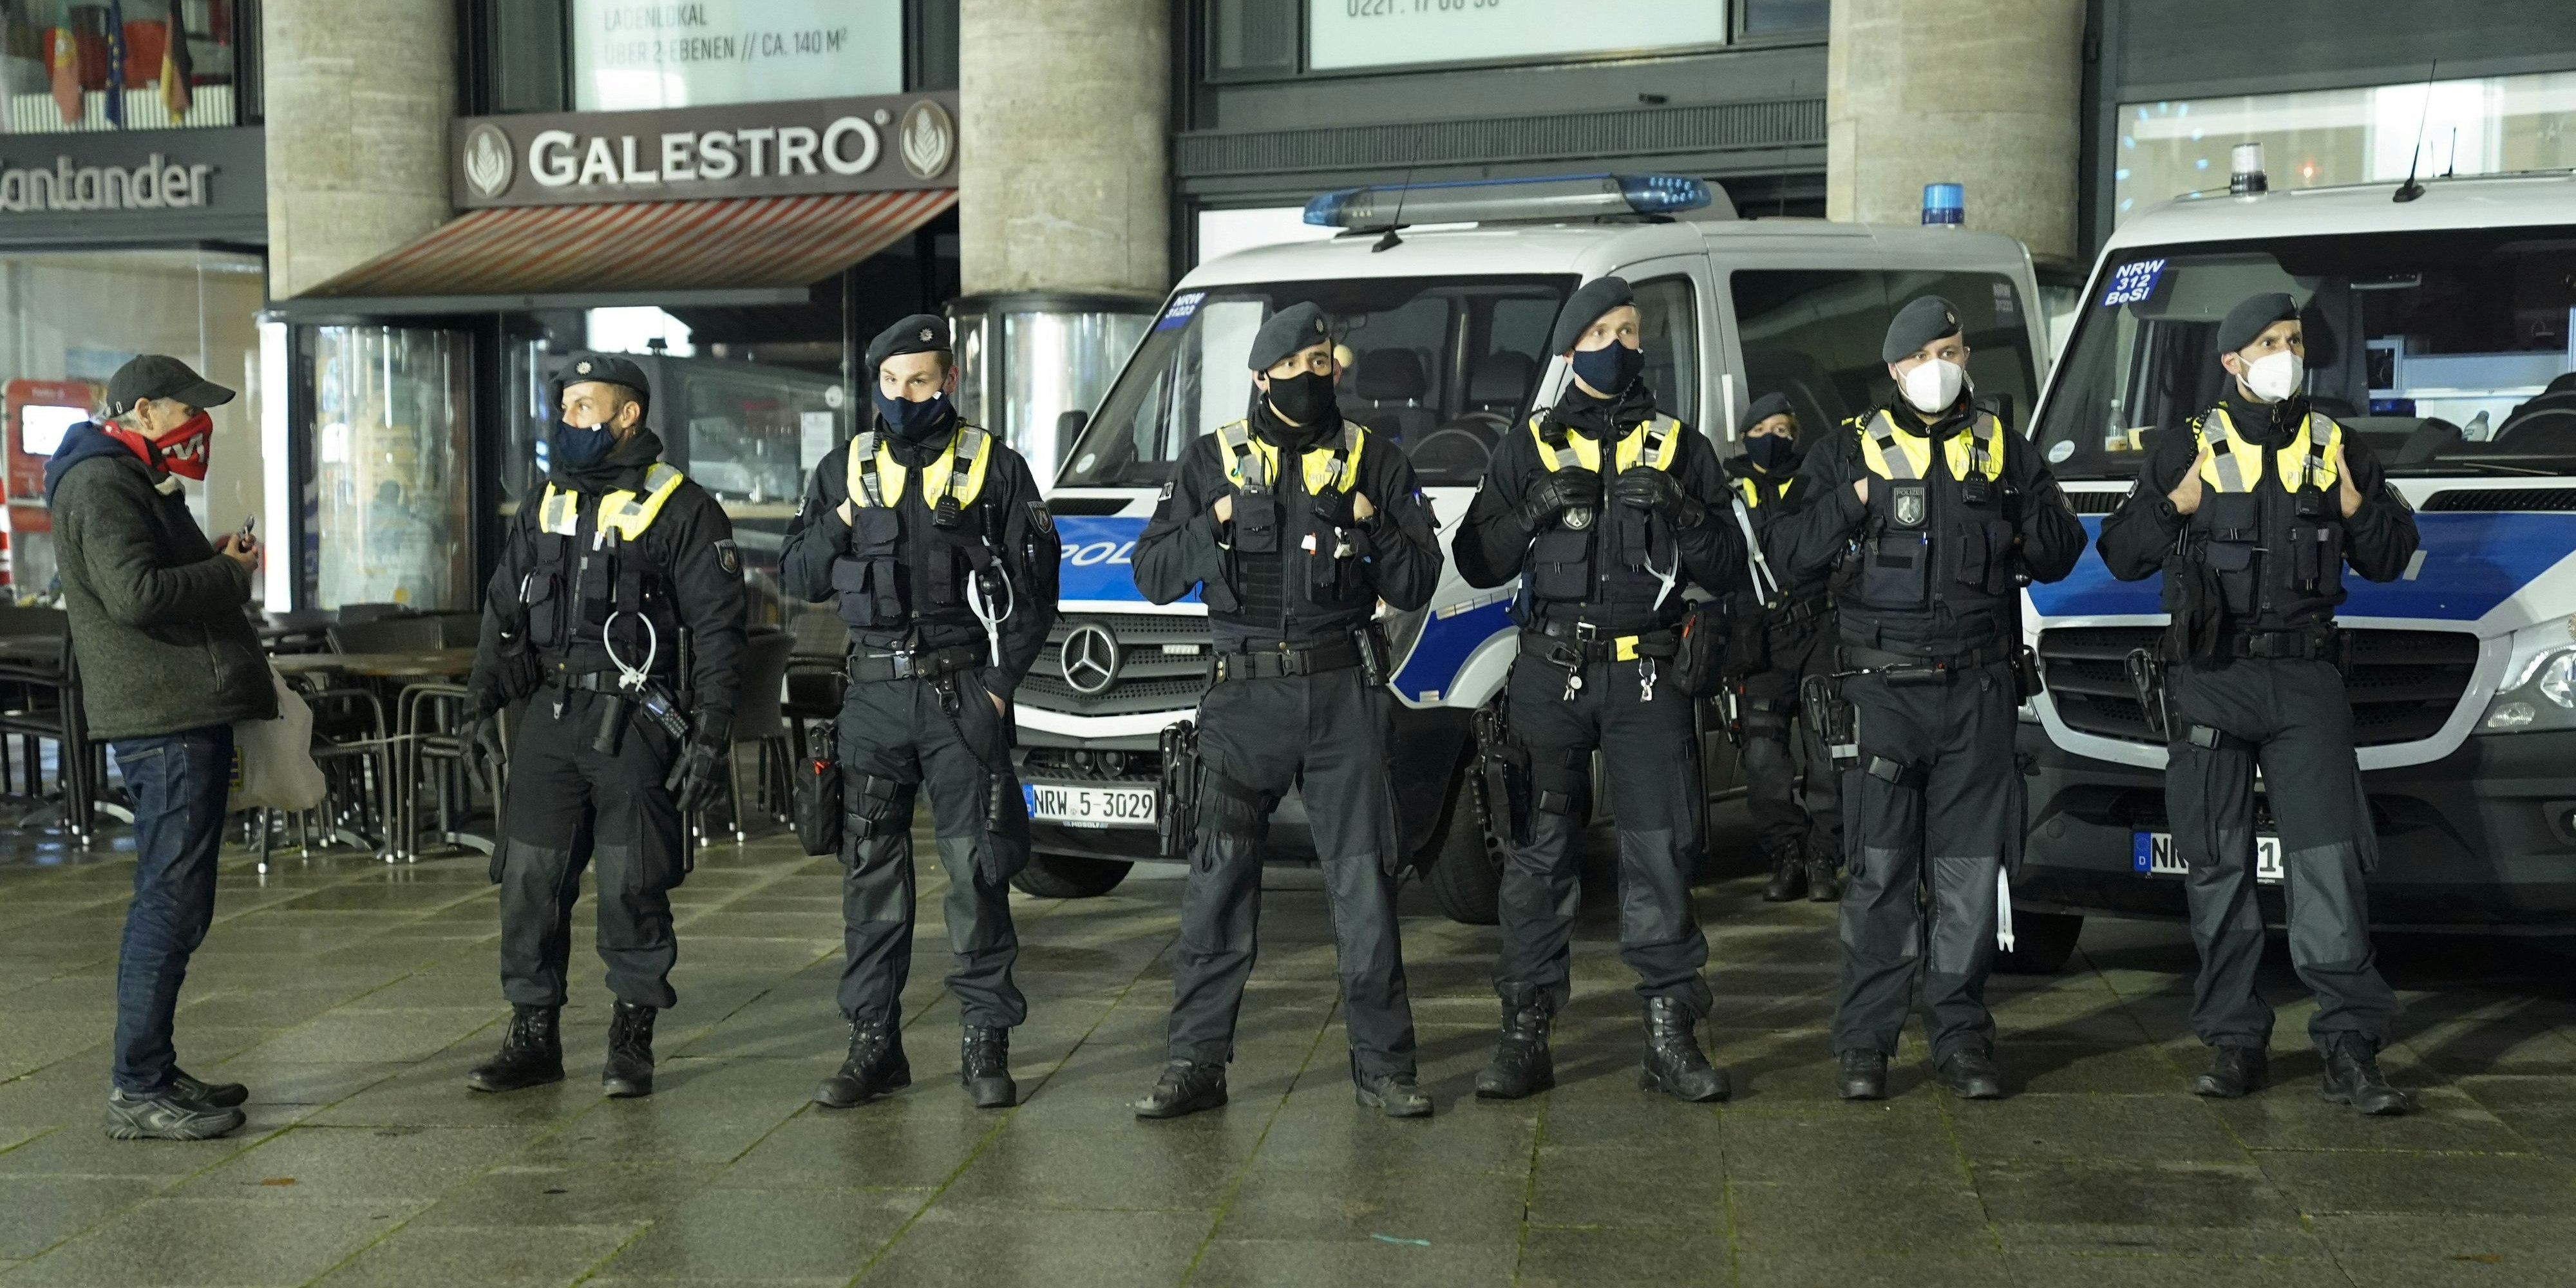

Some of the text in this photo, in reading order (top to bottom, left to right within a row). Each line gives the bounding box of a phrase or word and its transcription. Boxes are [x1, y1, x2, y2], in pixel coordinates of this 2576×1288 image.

[604, 4, 708, 32] LADENLOKAL
[794, 30, 820, 55] 140
[529, 116, 880, 187] GALESTRO
[0, 153, 210, 212] antander
[2116, 259, 2165, 278] NRW
[2117, 274, 2151, 291] 312
[1172, 292, 1205, 308] NRW
[1034, 790, 1066, 815] NRW
